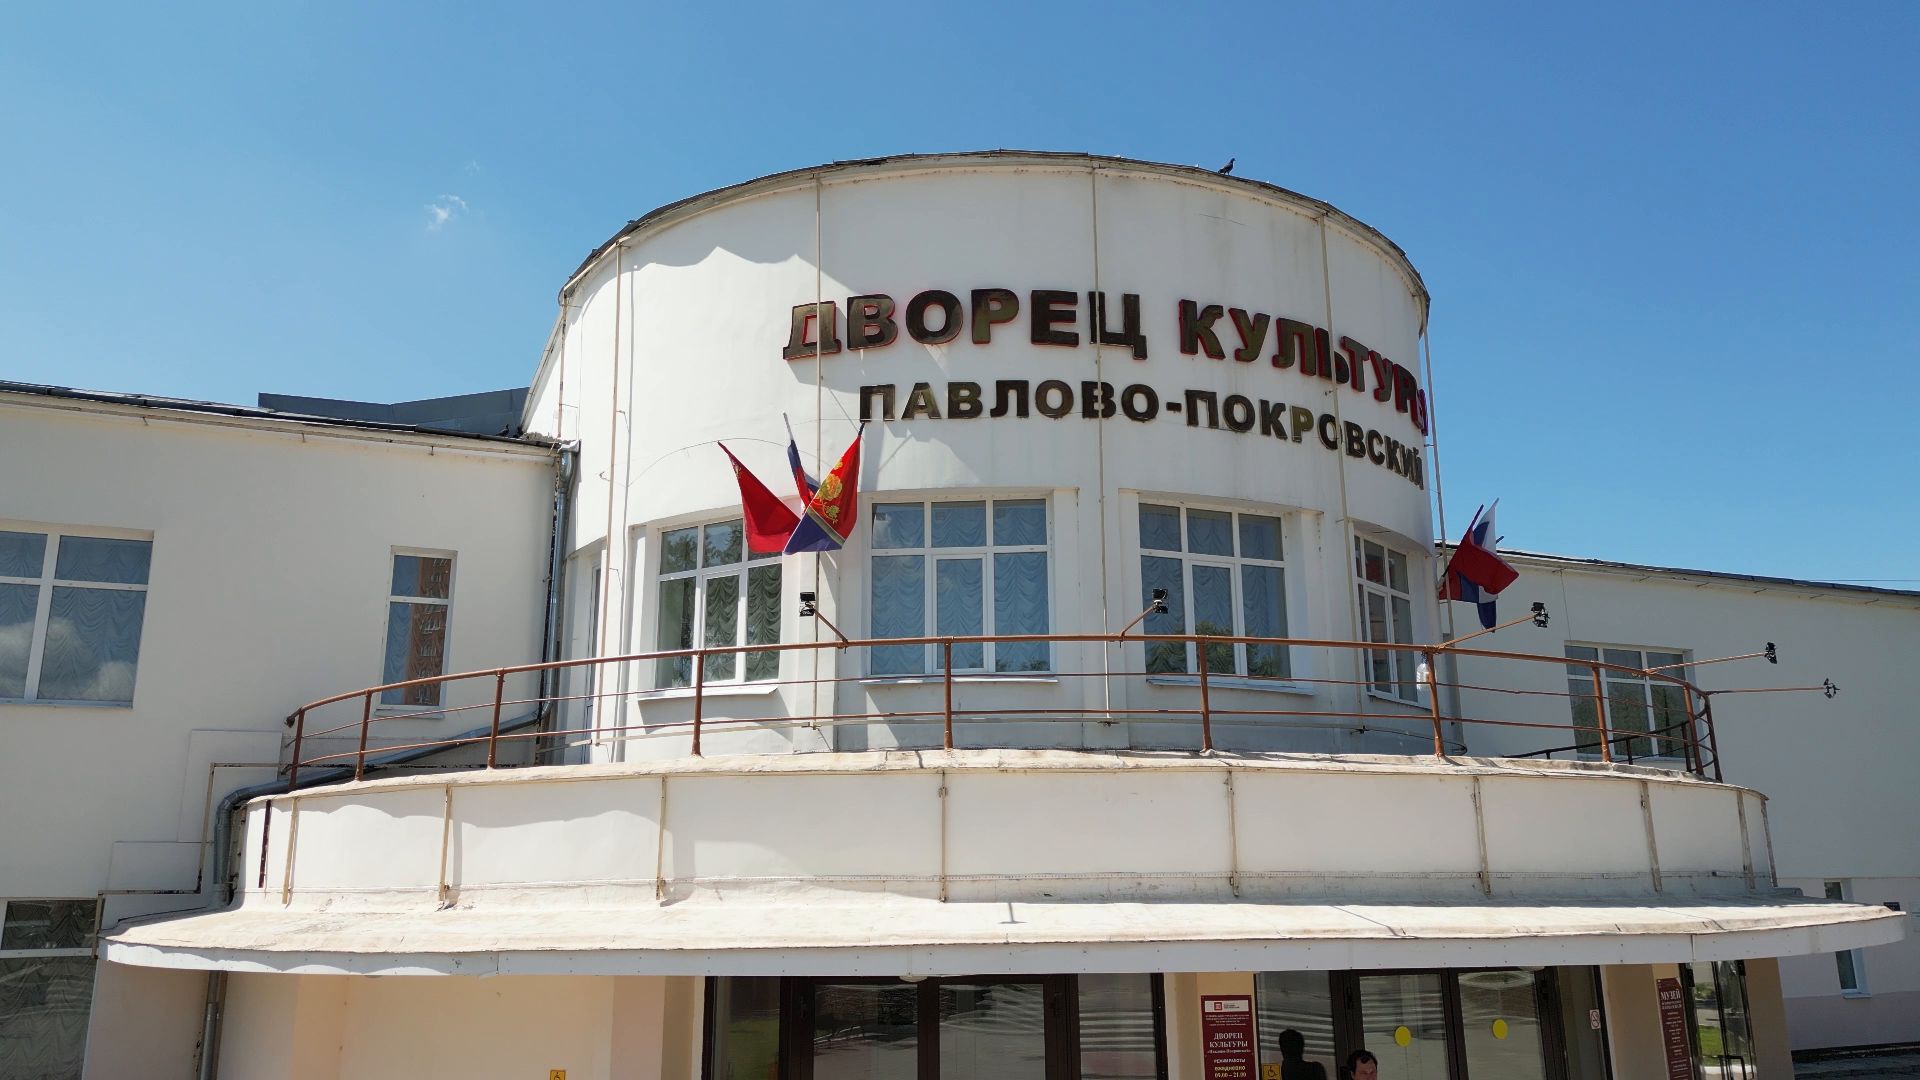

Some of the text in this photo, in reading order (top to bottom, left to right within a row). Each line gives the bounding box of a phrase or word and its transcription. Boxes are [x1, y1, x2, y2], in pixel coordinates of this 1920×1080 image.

[783, 288, 1428, 436] ДВОРЕЦ КУЛЬТУРЫ
[858, 379, 1424, 490] ПАВЛОВО-ПОКРОВСКИЙ
[1660, 989, 1681, 1001] МУЗЕЙ
